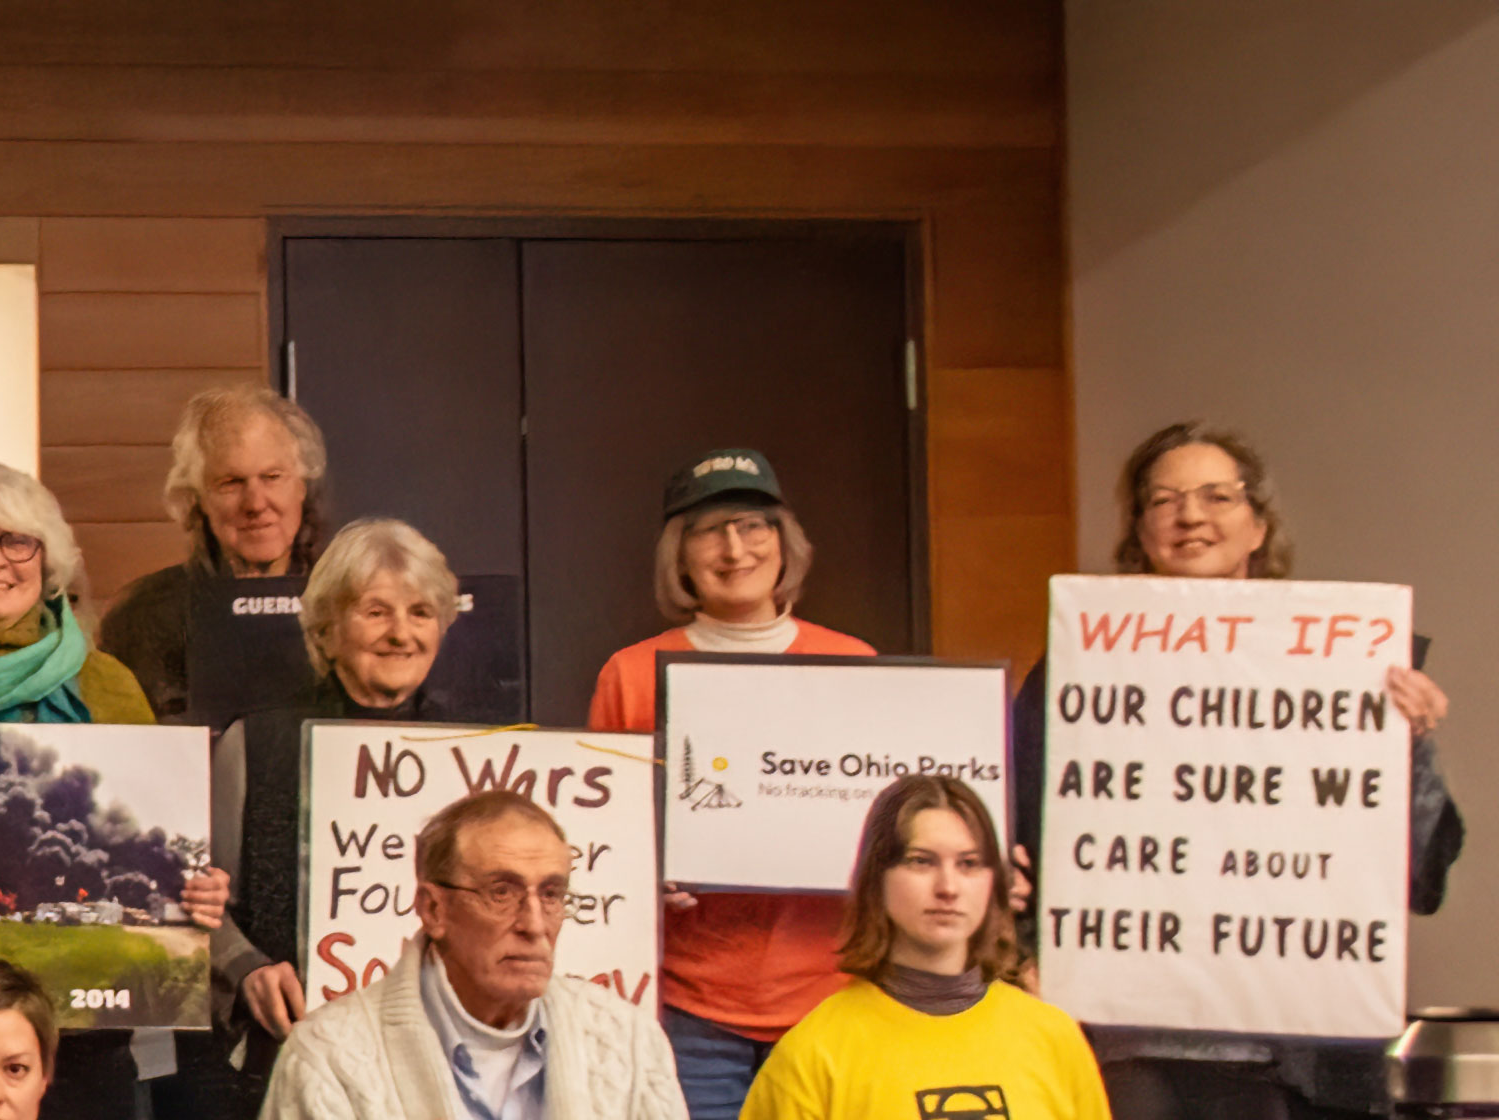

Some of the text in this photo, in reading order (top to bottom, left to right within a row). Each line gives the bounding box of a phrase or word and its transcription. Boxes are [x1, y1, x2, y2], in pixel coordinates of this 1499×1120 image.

[1080, 612, 1395, 657] WHAT IF?
[1059, 683, 1386, 732] OUR CHILDREN
[354, 741, 426, 798] NO
[762, 751, 1000, 781] Save Ohio Parks
[1058, 760, 1382, 808] ARE SURE WE
[331, 820, 404, 860] We
[1074, 833, 1333, 879] CARE ABOUT
[1049, 908, 1387, 962] THEIR FUTURE
[70, 988, 130, 1009] 2014
